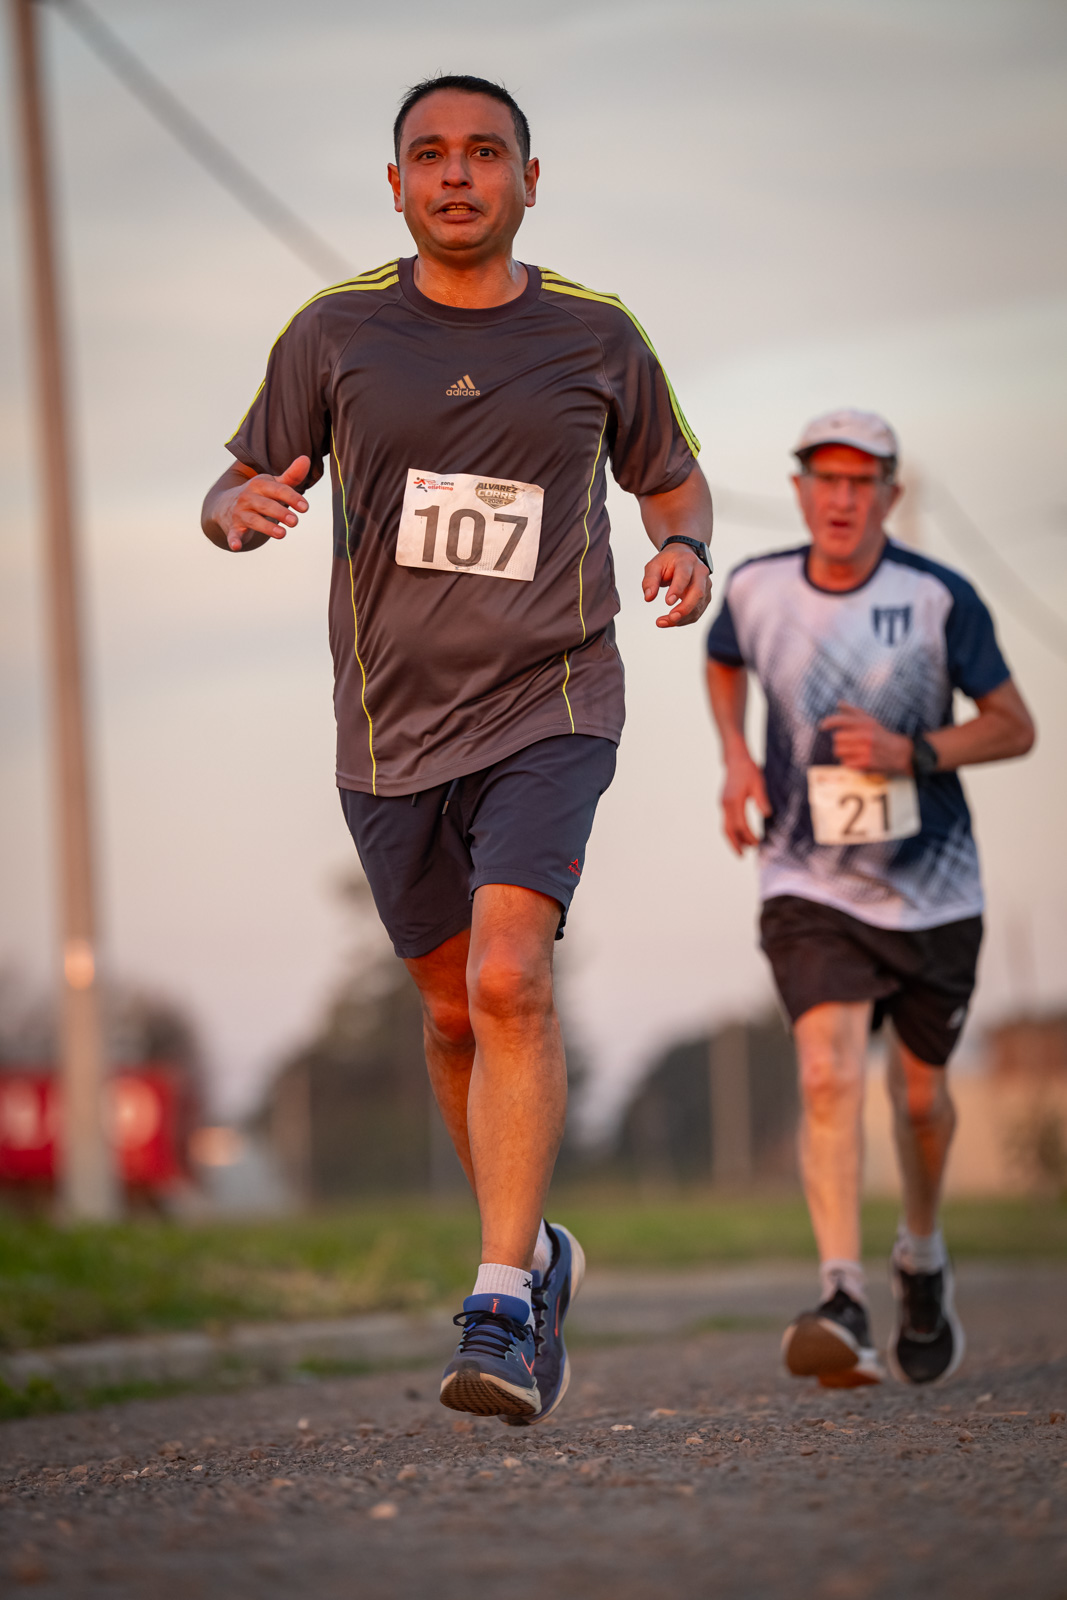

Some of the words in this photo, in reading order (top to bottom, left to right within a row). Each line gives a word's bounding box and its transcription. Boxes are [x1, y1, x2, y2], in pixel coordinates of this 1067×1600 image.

[445, 387, 481, 397] adidas
[476, 482, 518, 493] ALVAREZ
[414, 505, 528, 572] 107
[839, 793, 890, 836] 21
